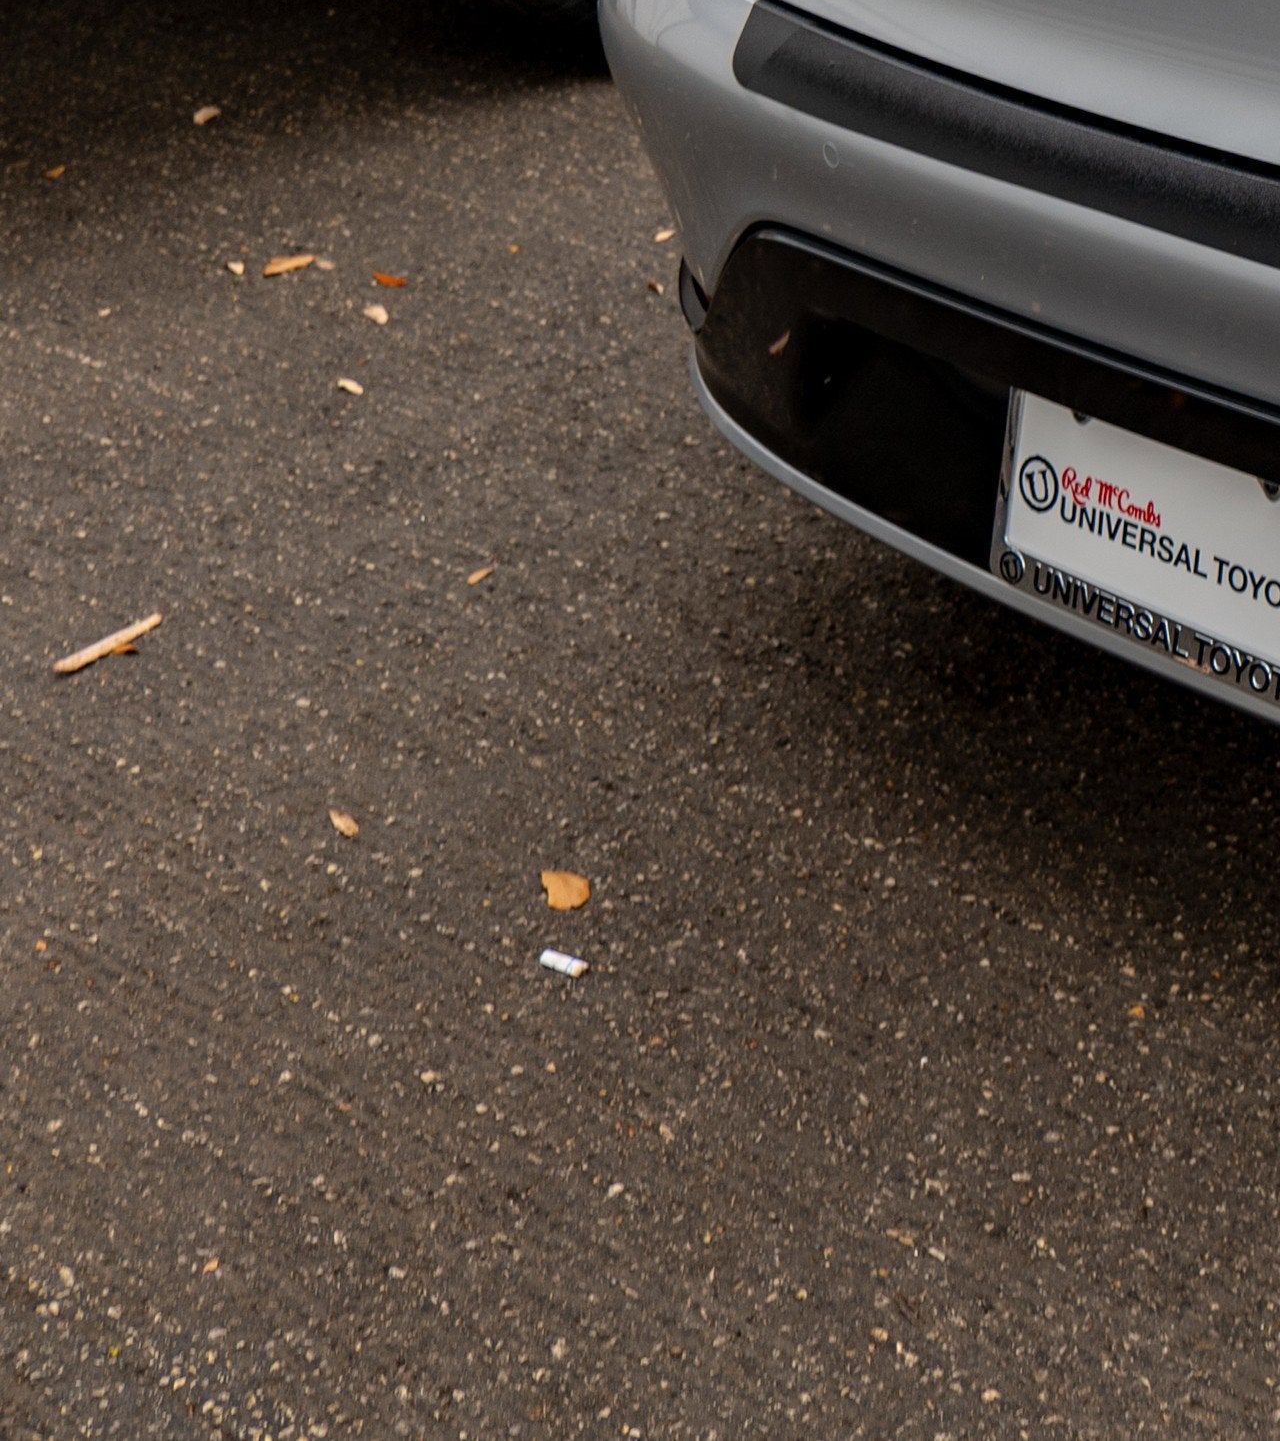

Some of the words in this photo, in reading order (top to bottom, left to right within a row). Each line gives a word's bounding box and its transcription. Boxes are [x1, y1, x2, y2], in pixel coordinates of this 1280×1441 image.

[1060, 495, 1207, 579] UNIVERSAL
[1061, 466, 1093, 506] Red
[1095, 477, 1161, 528] McCombs
[1034, 562, 1188, 658] UNIVERSAL
